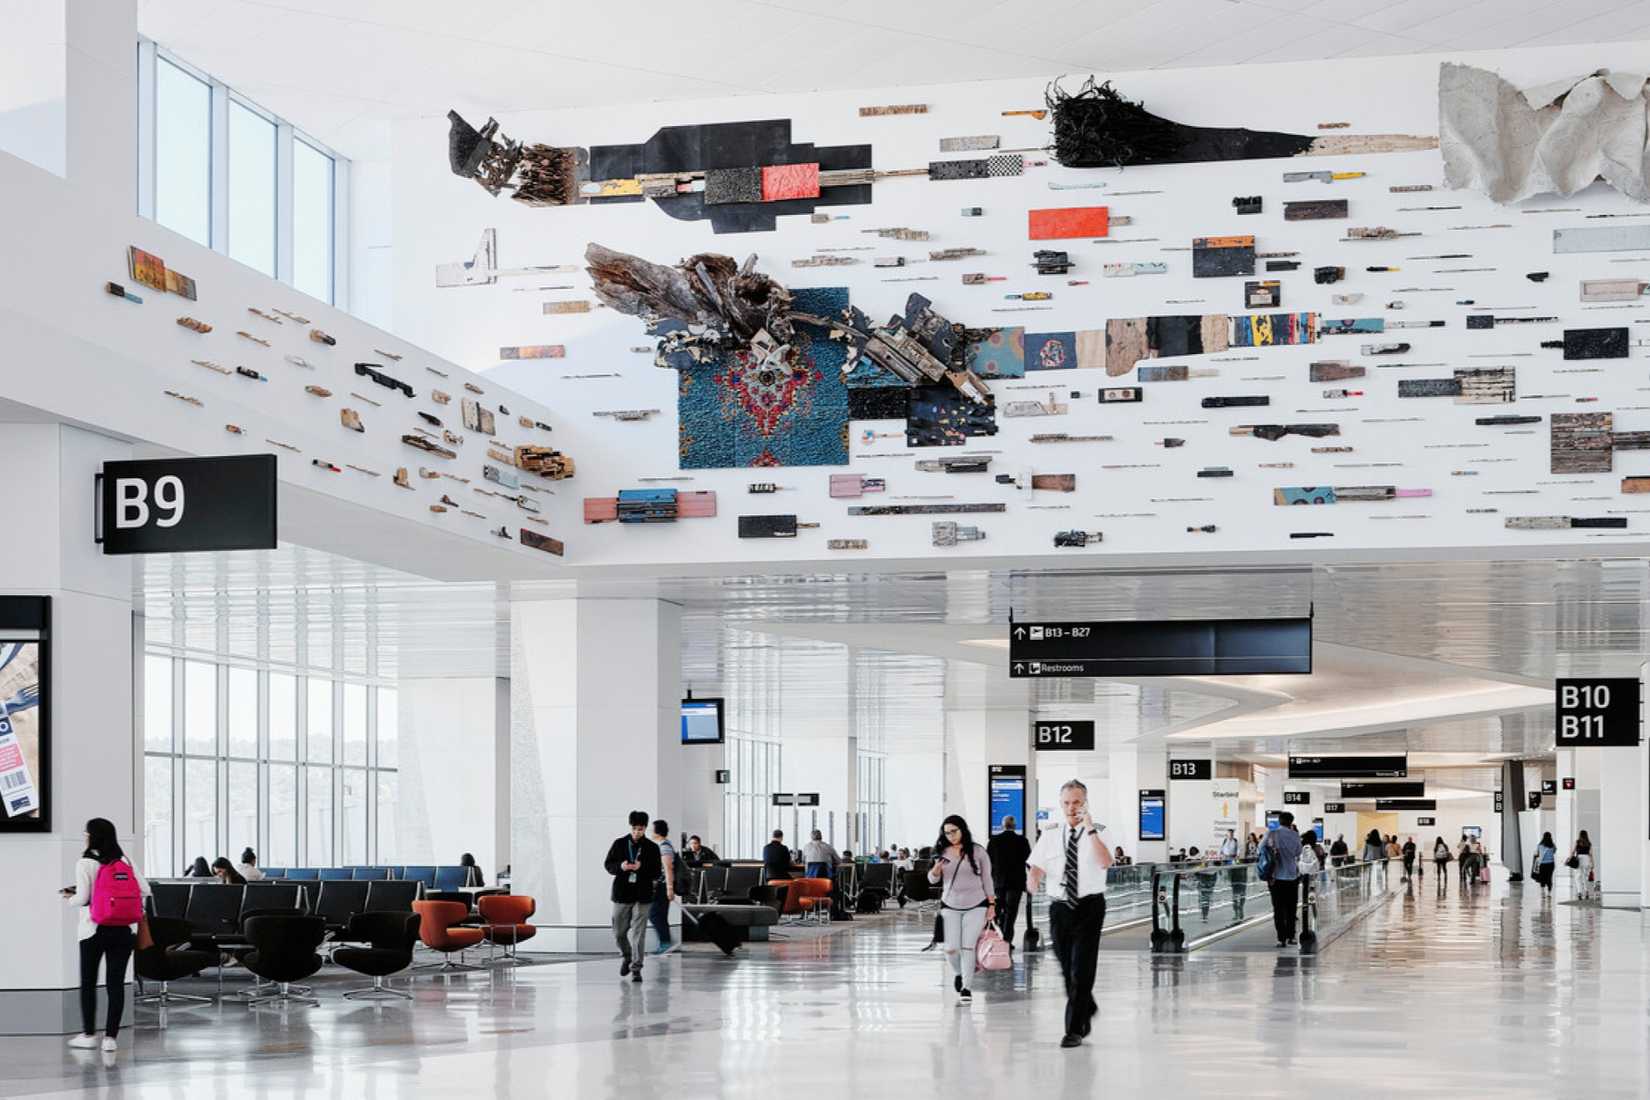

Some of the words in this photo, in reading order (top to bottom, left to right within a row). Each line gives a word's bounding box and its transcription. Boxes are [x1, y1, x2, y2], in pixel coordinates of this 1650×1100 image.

[116, 475, 184, 528] B9
[1045, 627, 1063, 638] B13
[1072, 627, 1090, 637] B27
[1041, 663, 1084, 672] Restrooms
[1562, 686, 1610, 709] B10
[1562, 715, 1604, 738] B11
[1038, 726, 1072, 743] B12
[1173, 763, 1195, 775] B13
[1285, 793, 1301, 802] B14
